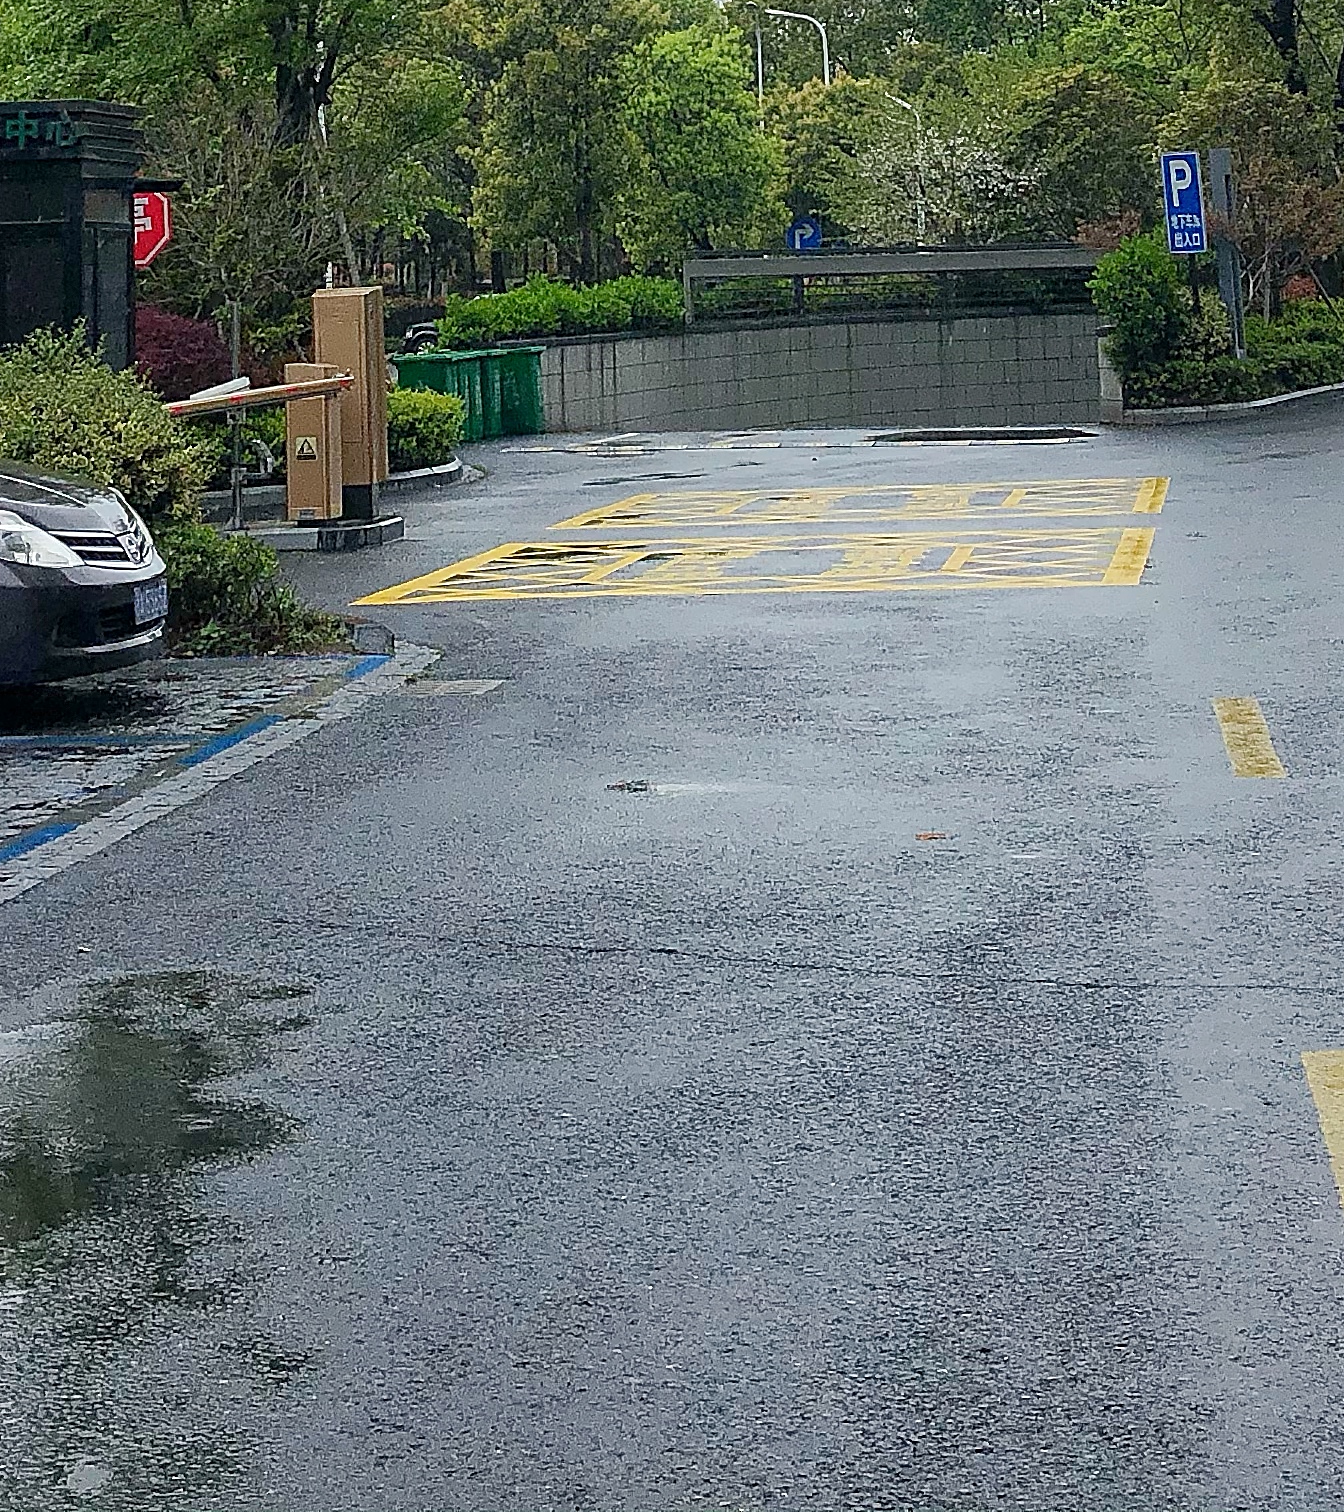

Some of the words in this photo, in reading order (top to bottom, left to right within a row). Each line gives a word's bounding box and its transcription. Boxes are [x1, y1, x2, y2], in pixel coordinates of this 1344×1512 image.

[1169, 159, 1192, 207] P
[1174, 231, 1201, 248] 出入口
